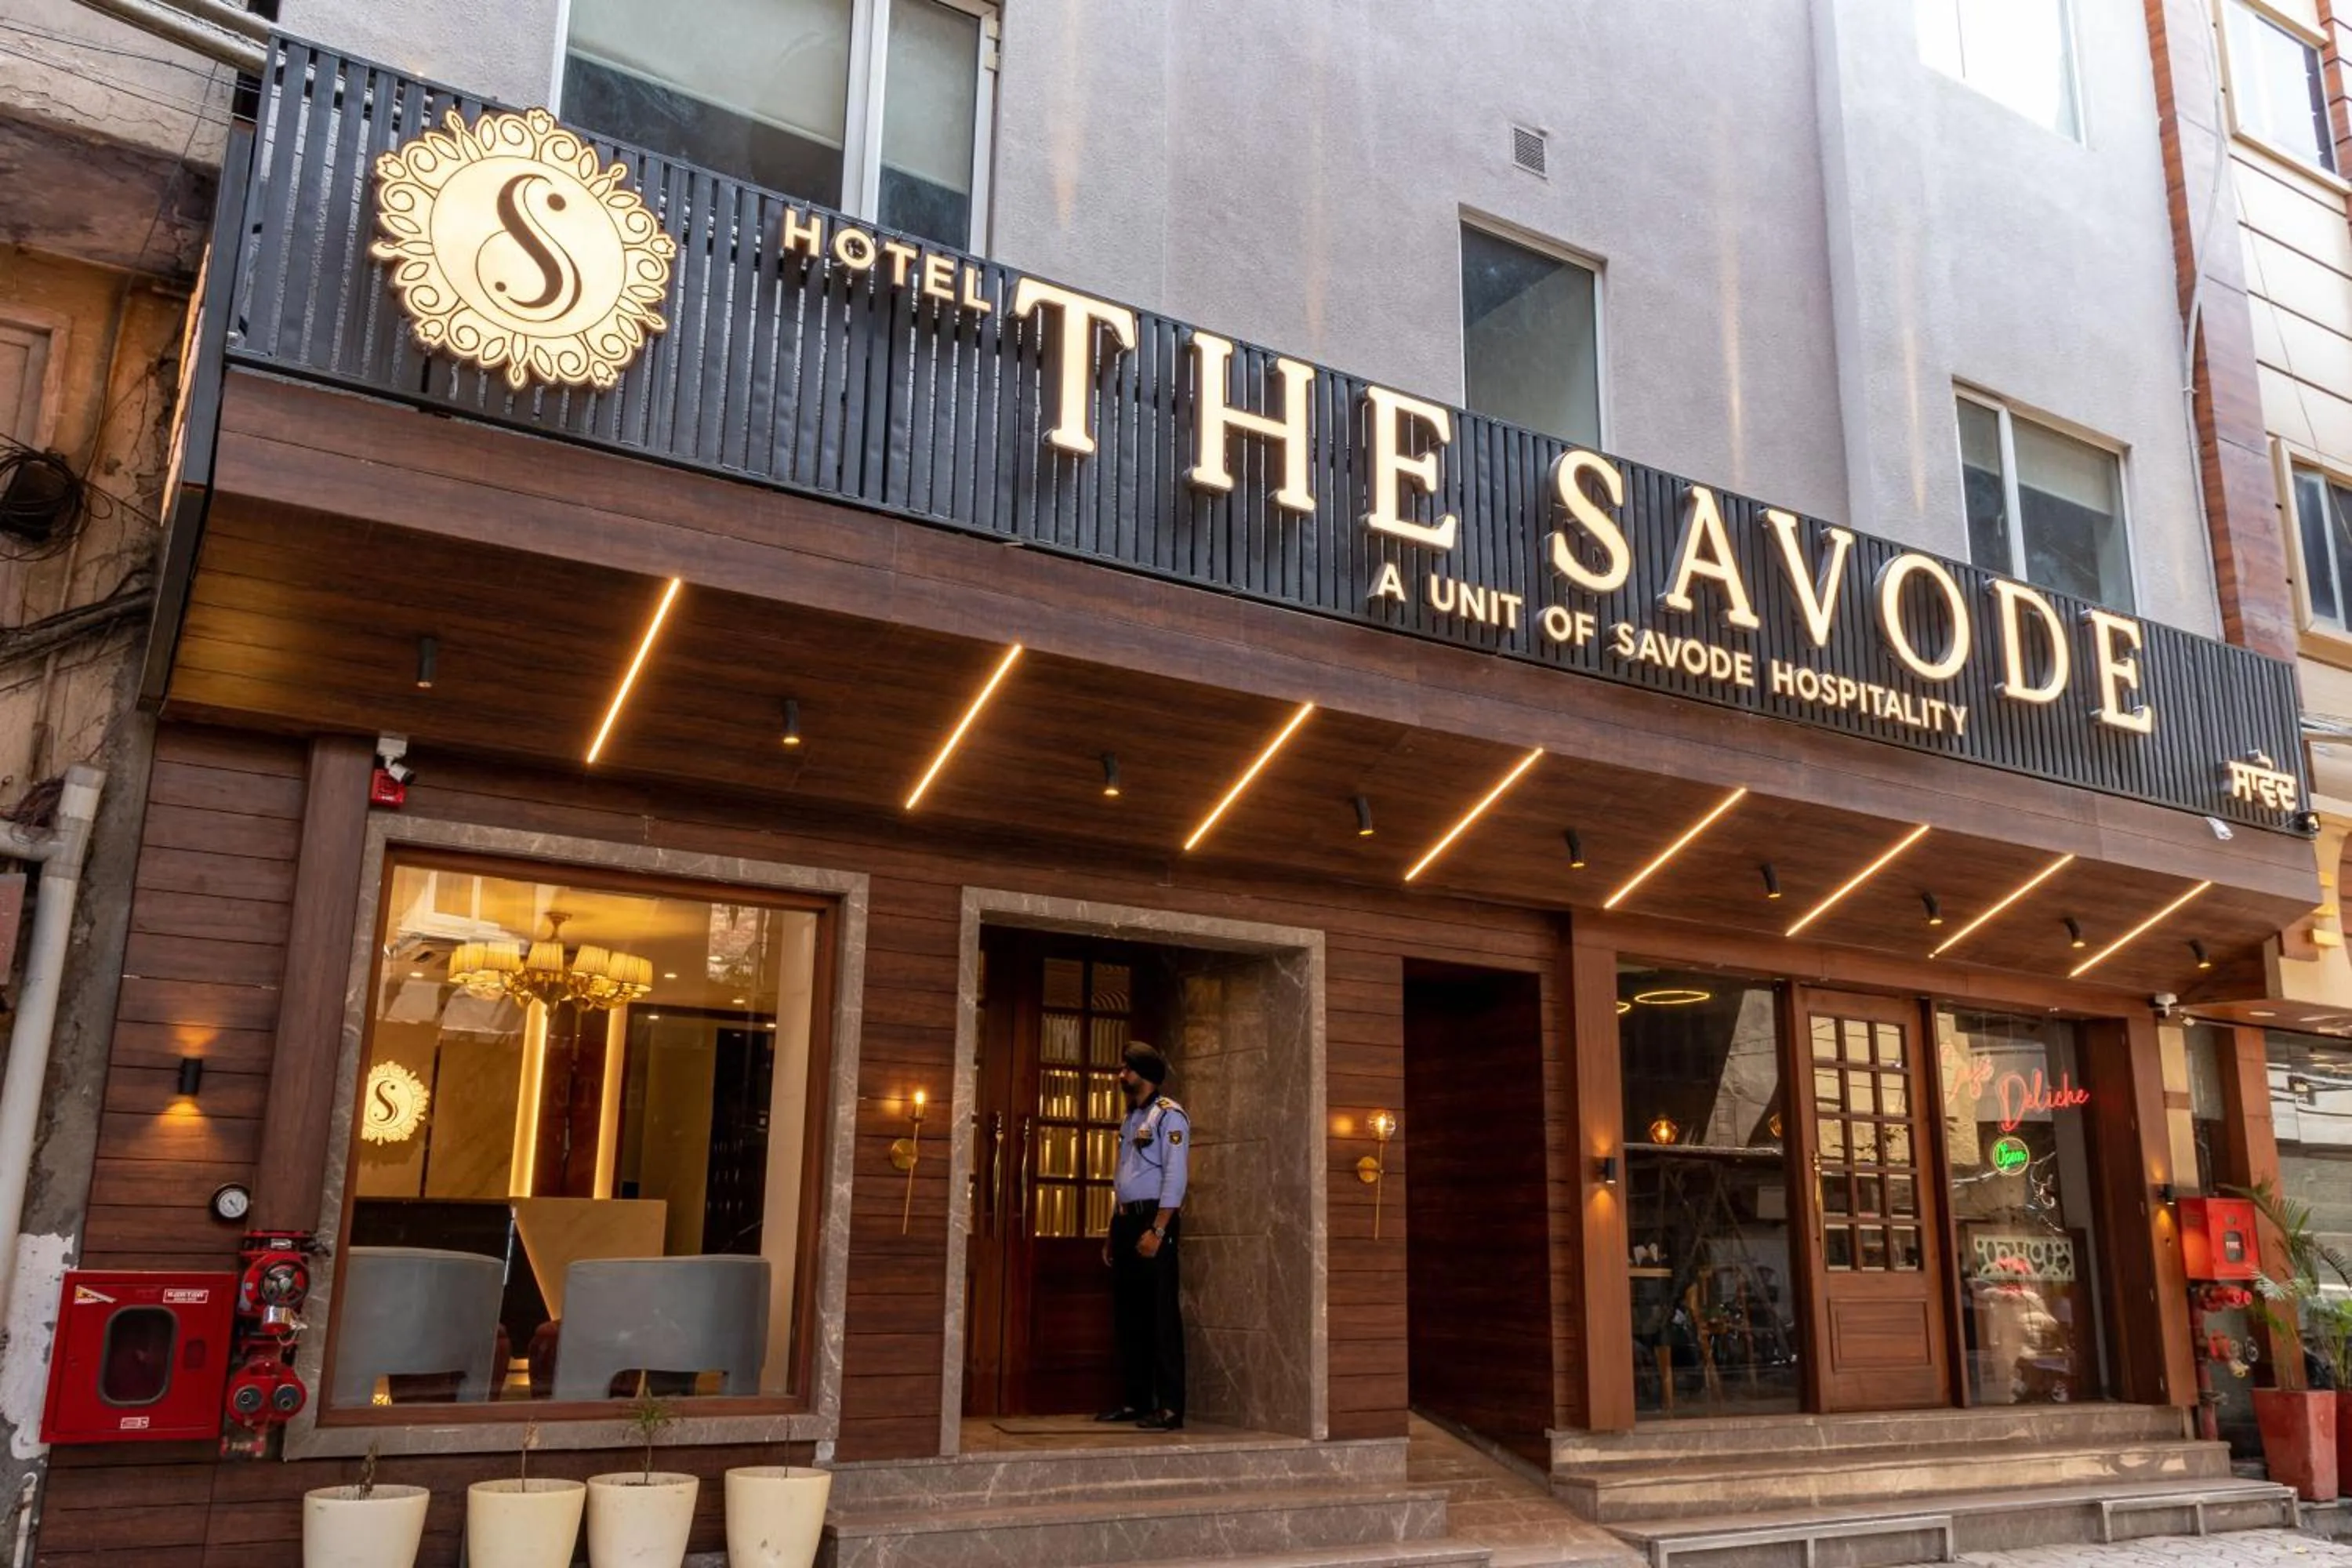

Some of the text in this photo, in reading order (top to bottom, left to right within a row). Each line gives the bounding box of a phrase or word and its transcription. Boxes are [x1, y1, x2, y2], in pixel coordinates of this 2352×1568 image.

[783, 208, 992, 312] HOTEL
[1014, 276, 2154, 734] THE SAVODE
[1376, 561, 1967, 736] A UNIT OF SAVODE HOSPITALITY
